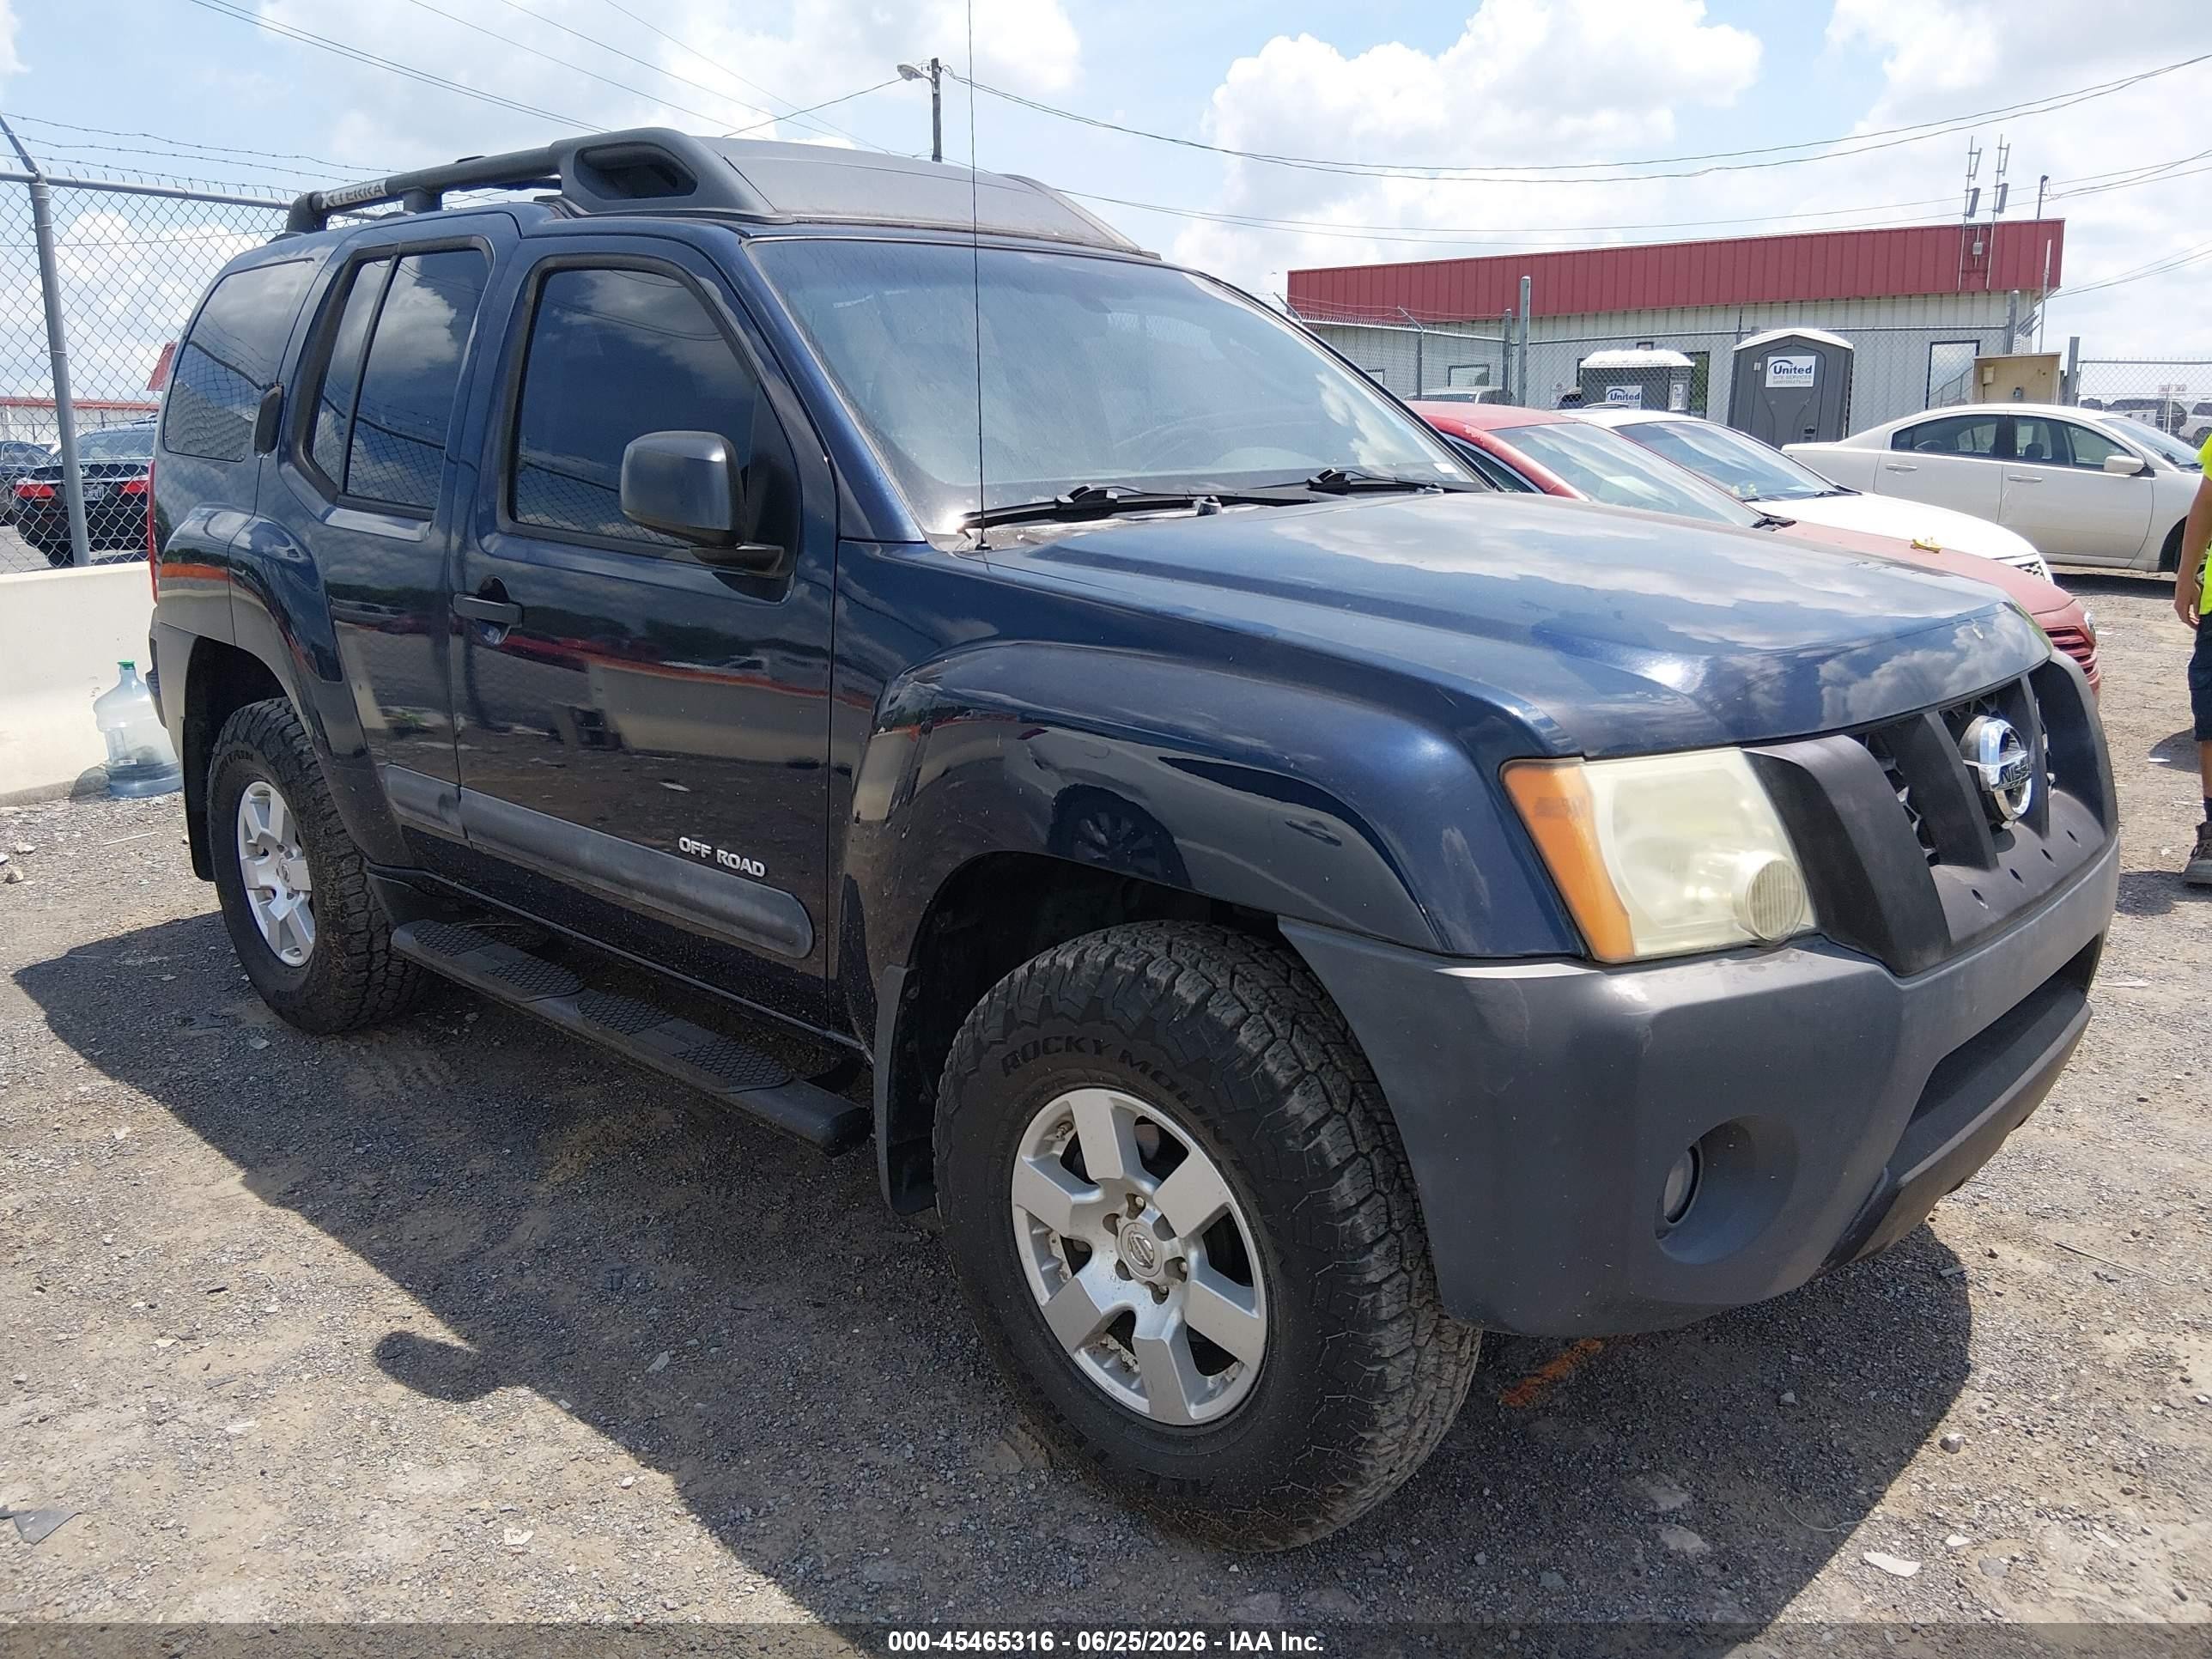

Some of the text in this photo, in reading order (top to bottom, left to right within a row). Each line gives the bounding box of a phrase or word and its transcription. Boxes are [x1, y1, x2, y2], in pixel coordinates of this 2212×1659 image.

[1773, 364, 1813, 374] United
[1610, 392, 1641, 401] United
[678, 836, 766, 878] OFF ROAD
[1001, 1036, 1113, 1077] ROCKY
